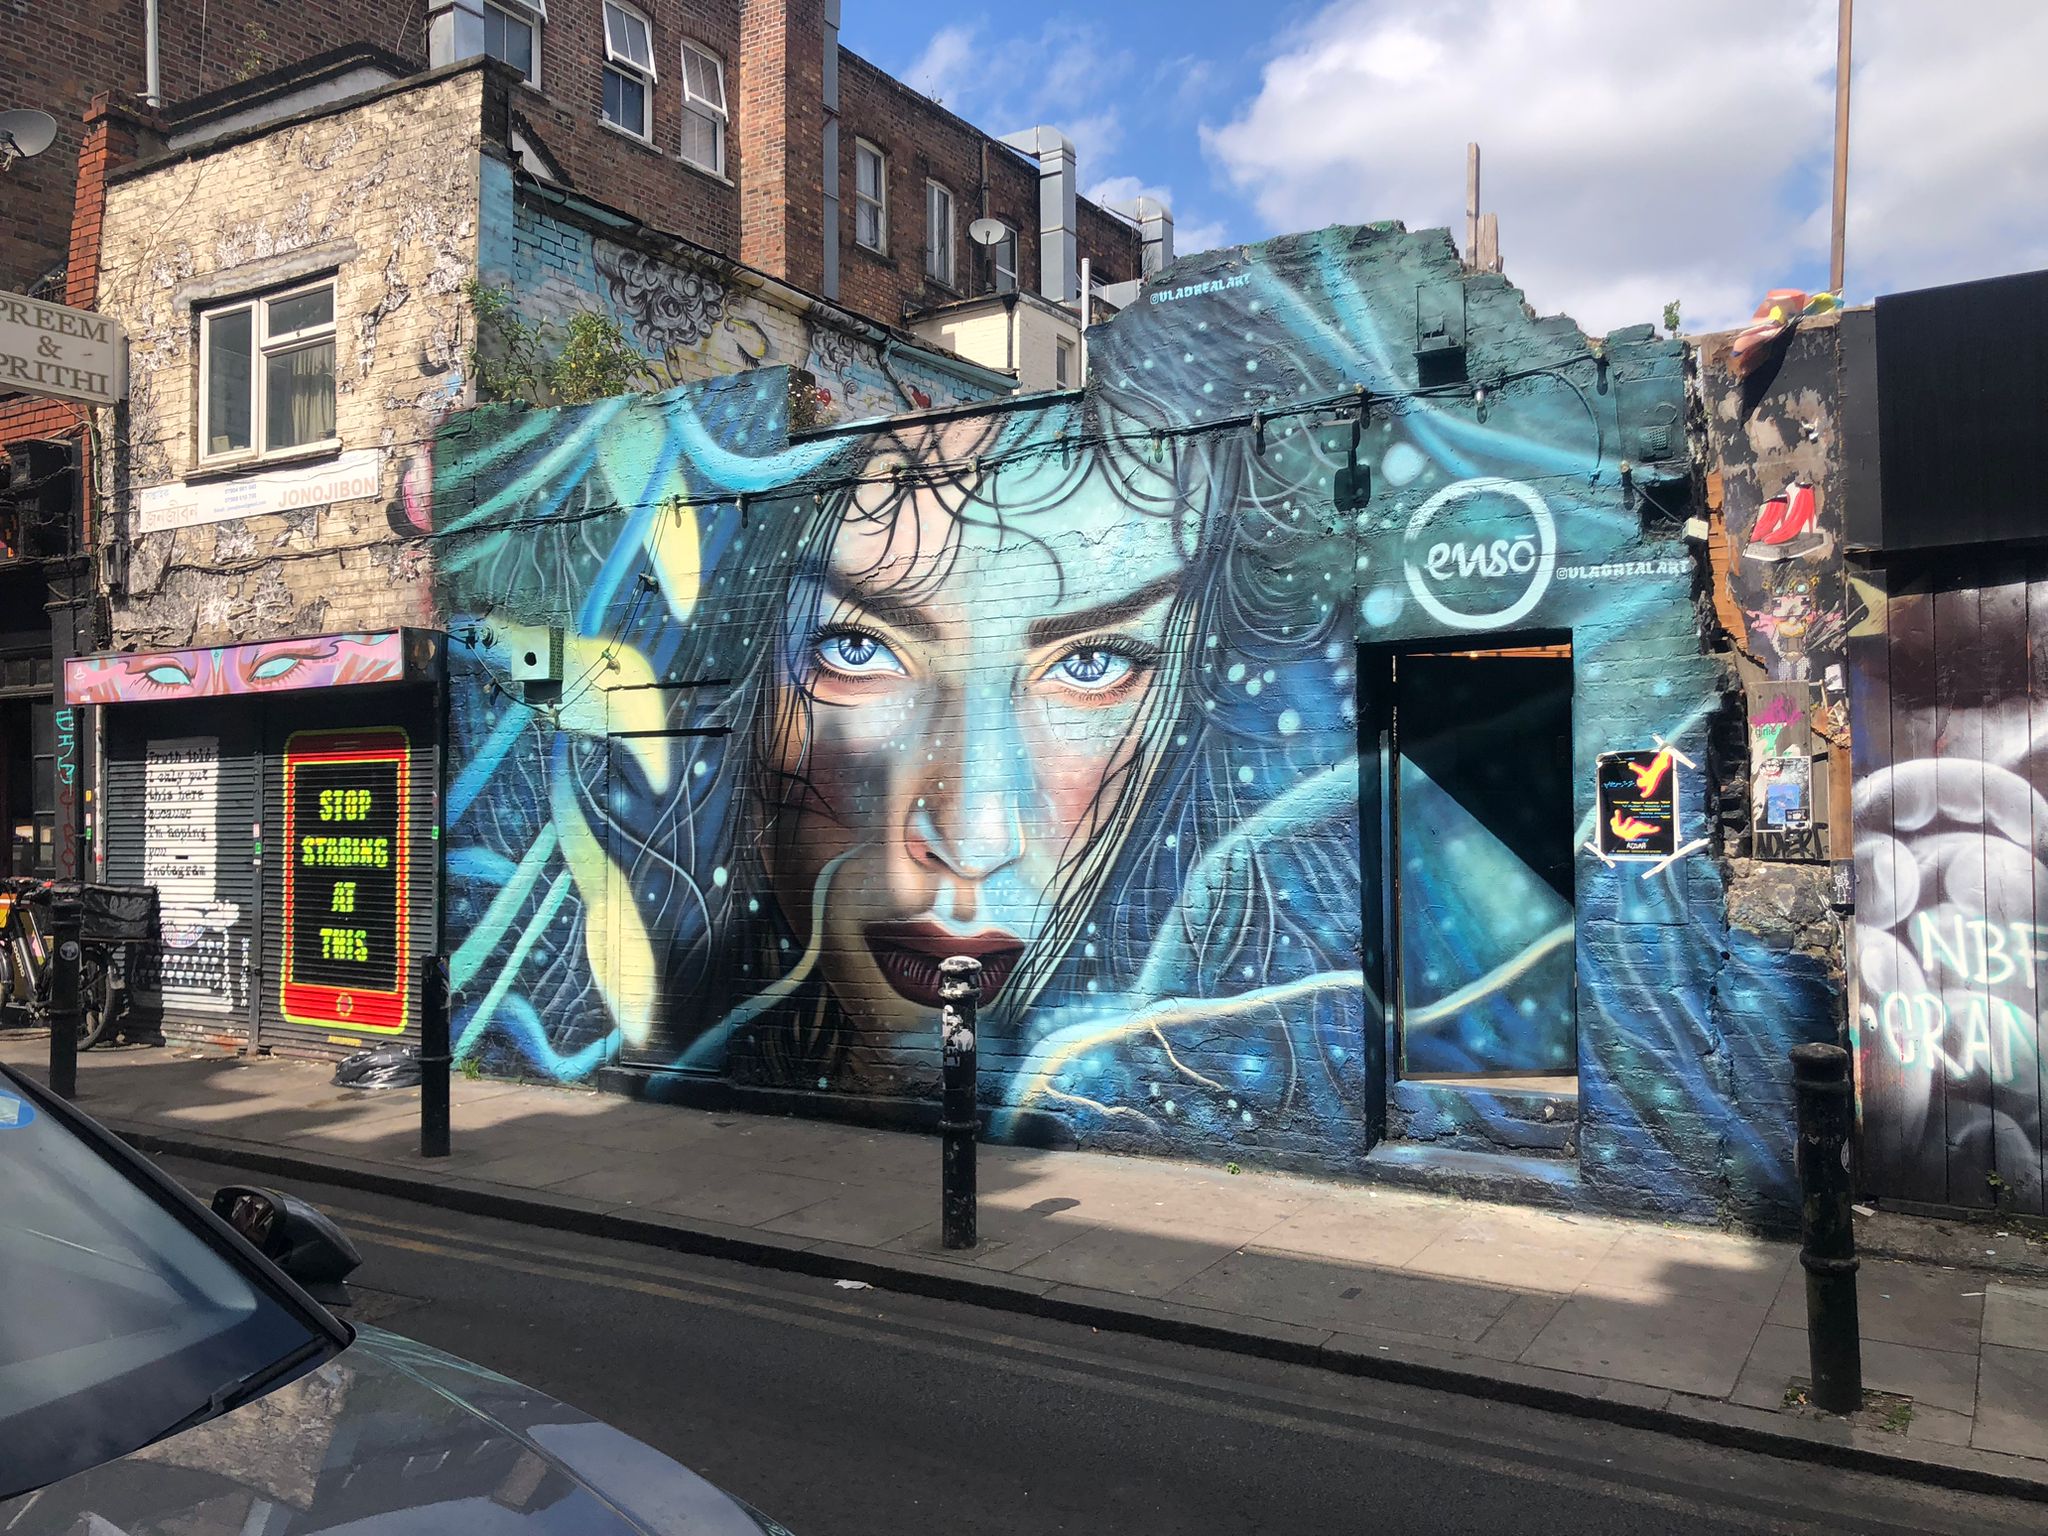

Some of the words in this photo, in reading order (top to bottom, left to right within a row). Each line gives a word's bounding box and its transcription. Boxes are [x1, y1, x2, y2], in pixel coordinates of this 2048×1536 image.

[37, 335, 62, 360] &
[278, 476, 376, 507] JONOJIBON
[148, 787, 173, 800] this
[178, 786, 204, 800] here
[319, 789, 372, 821] STOP
[302, 835, 388, 867] STARING
[331, 881, 356, 912] AT
[319, 928, 368, 962] THIS
